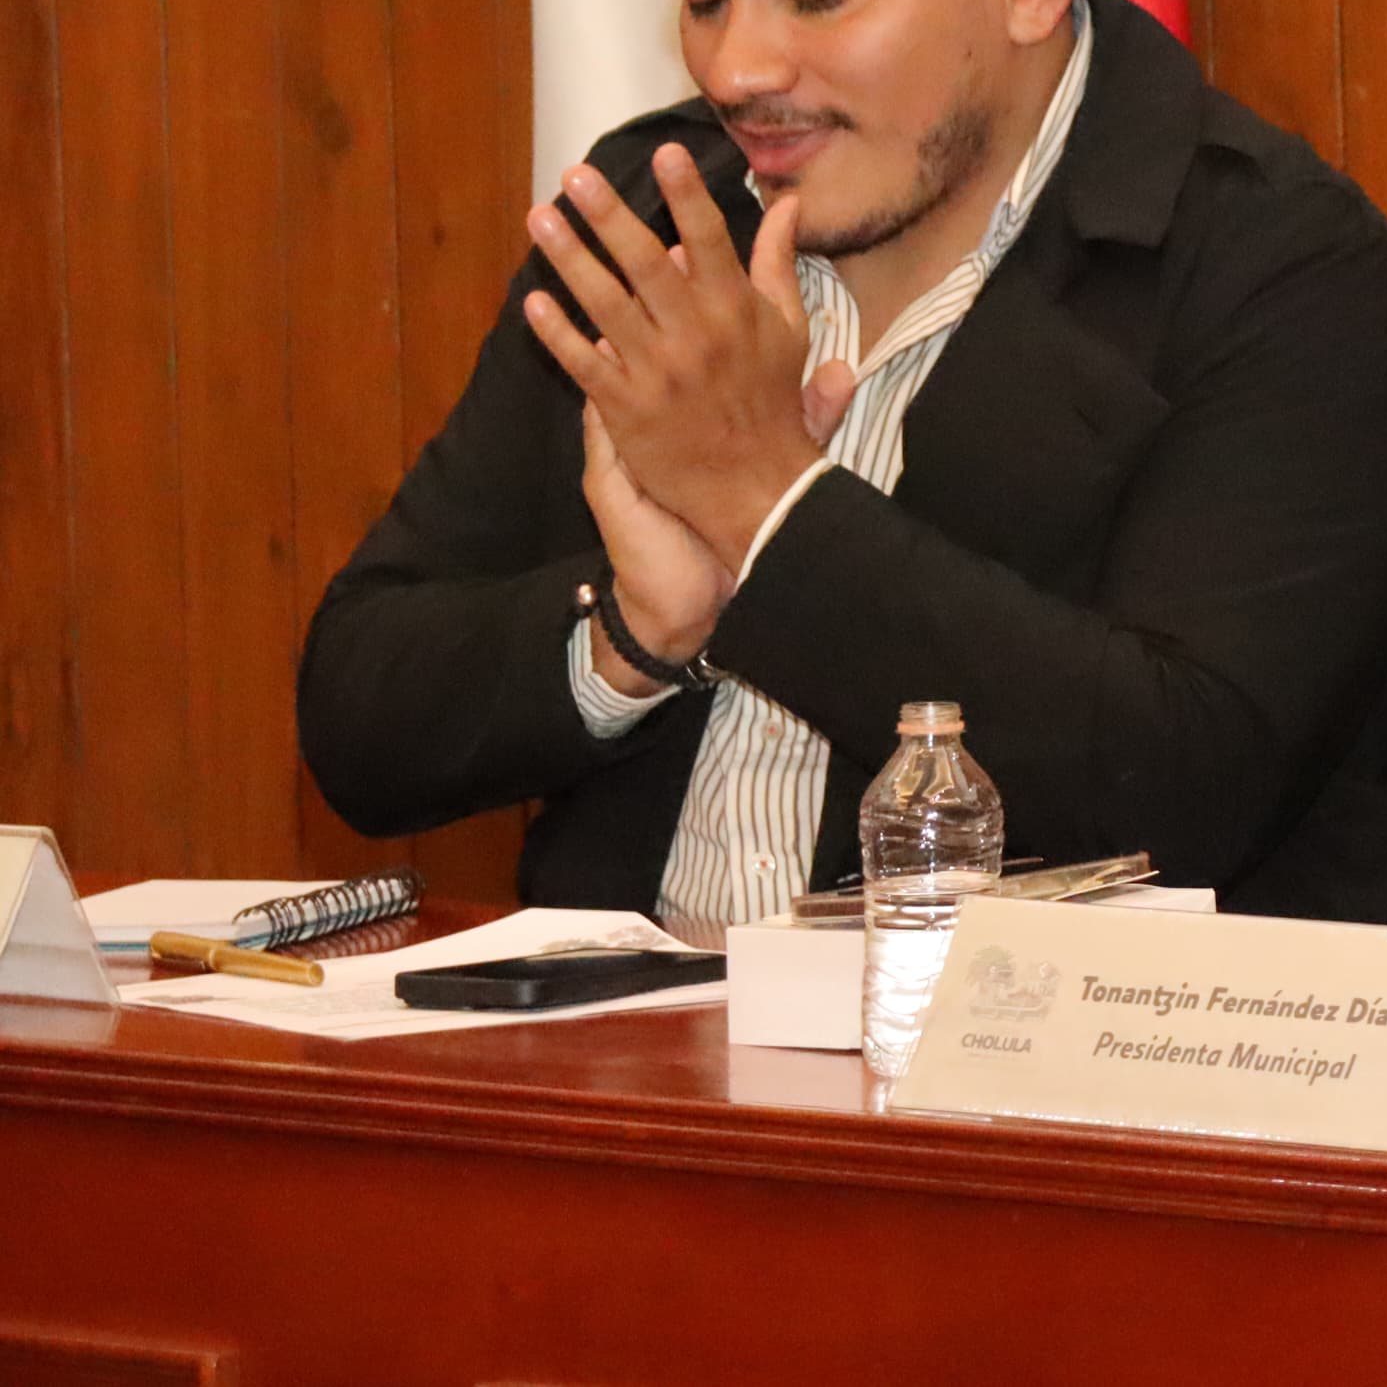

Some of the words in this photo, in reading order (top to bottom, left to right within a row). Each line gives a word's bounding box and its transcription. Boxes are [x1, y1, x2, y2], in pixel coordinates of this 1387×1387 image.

[1081, 975, 1200, 1016] Tonantzin
[1206, 986, 1340, 1022] Fernández
[961, 1032, 1033, 1054] CHOLULA
[1092, 1031, 1223, 1066] Presidenta
[1227, 1042, 1357, 1086] Municipal
